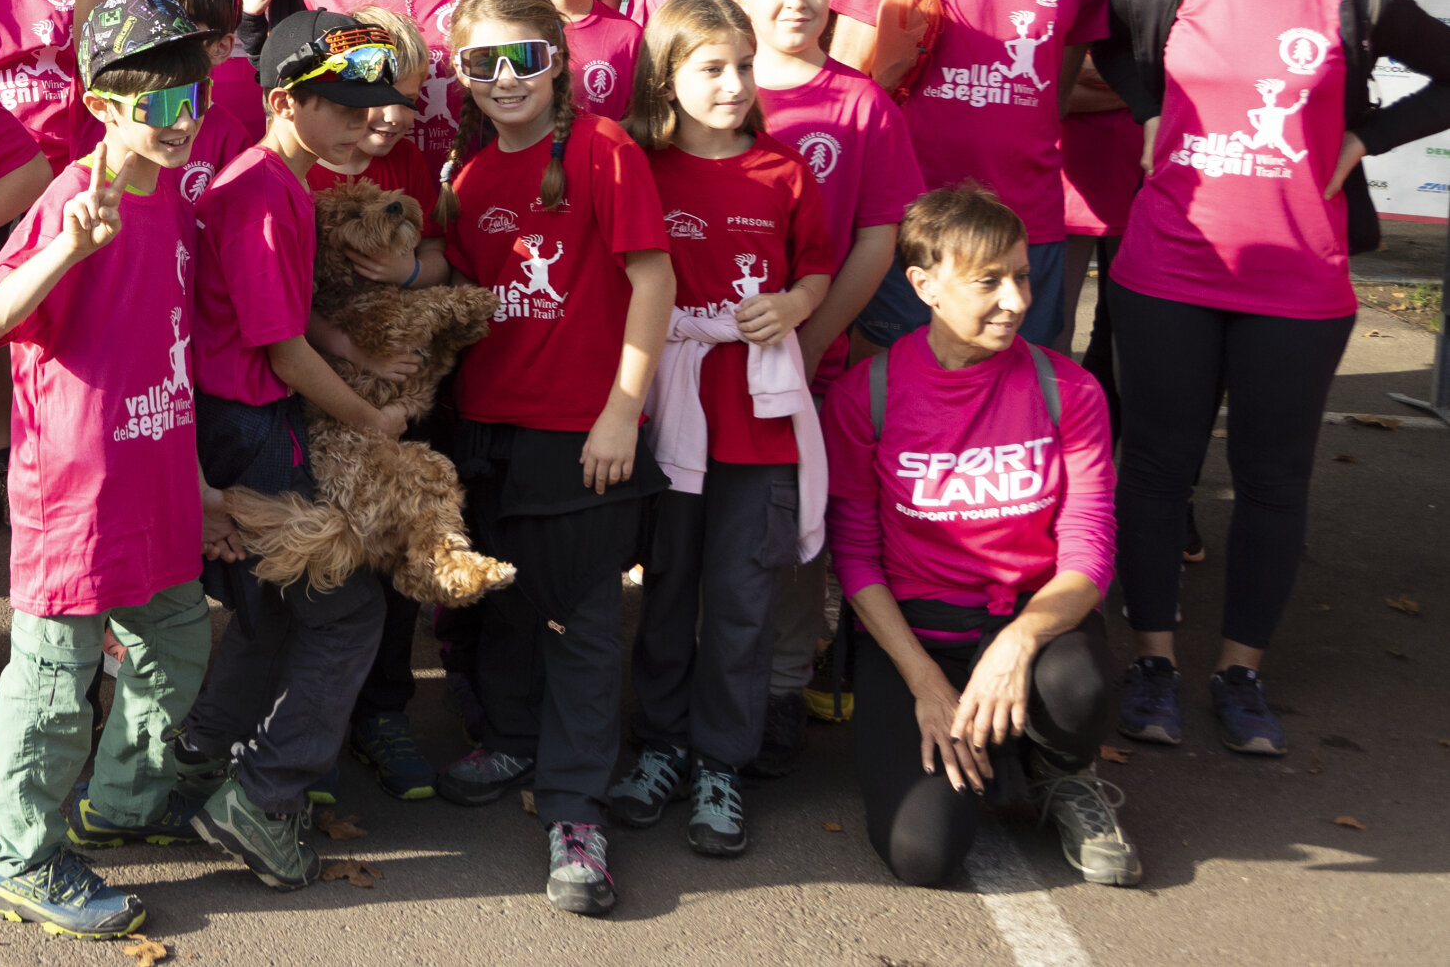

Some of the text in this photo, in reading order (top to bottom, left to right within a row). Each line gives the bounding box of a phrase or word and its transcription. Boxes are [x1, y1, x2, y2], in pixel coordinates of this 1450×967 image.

[41, 80, 65, 89] Wine
[942, 64, 1003, 87] valle
[1182, 133, 1245, 158] valle
[532, 298, 558, 309] Wine
[125, 385, 169, 417] valle
[912, 469, 1043, 506] LAND
[895, 496, 1056, 522] SUPPORT YOUR PASSION
